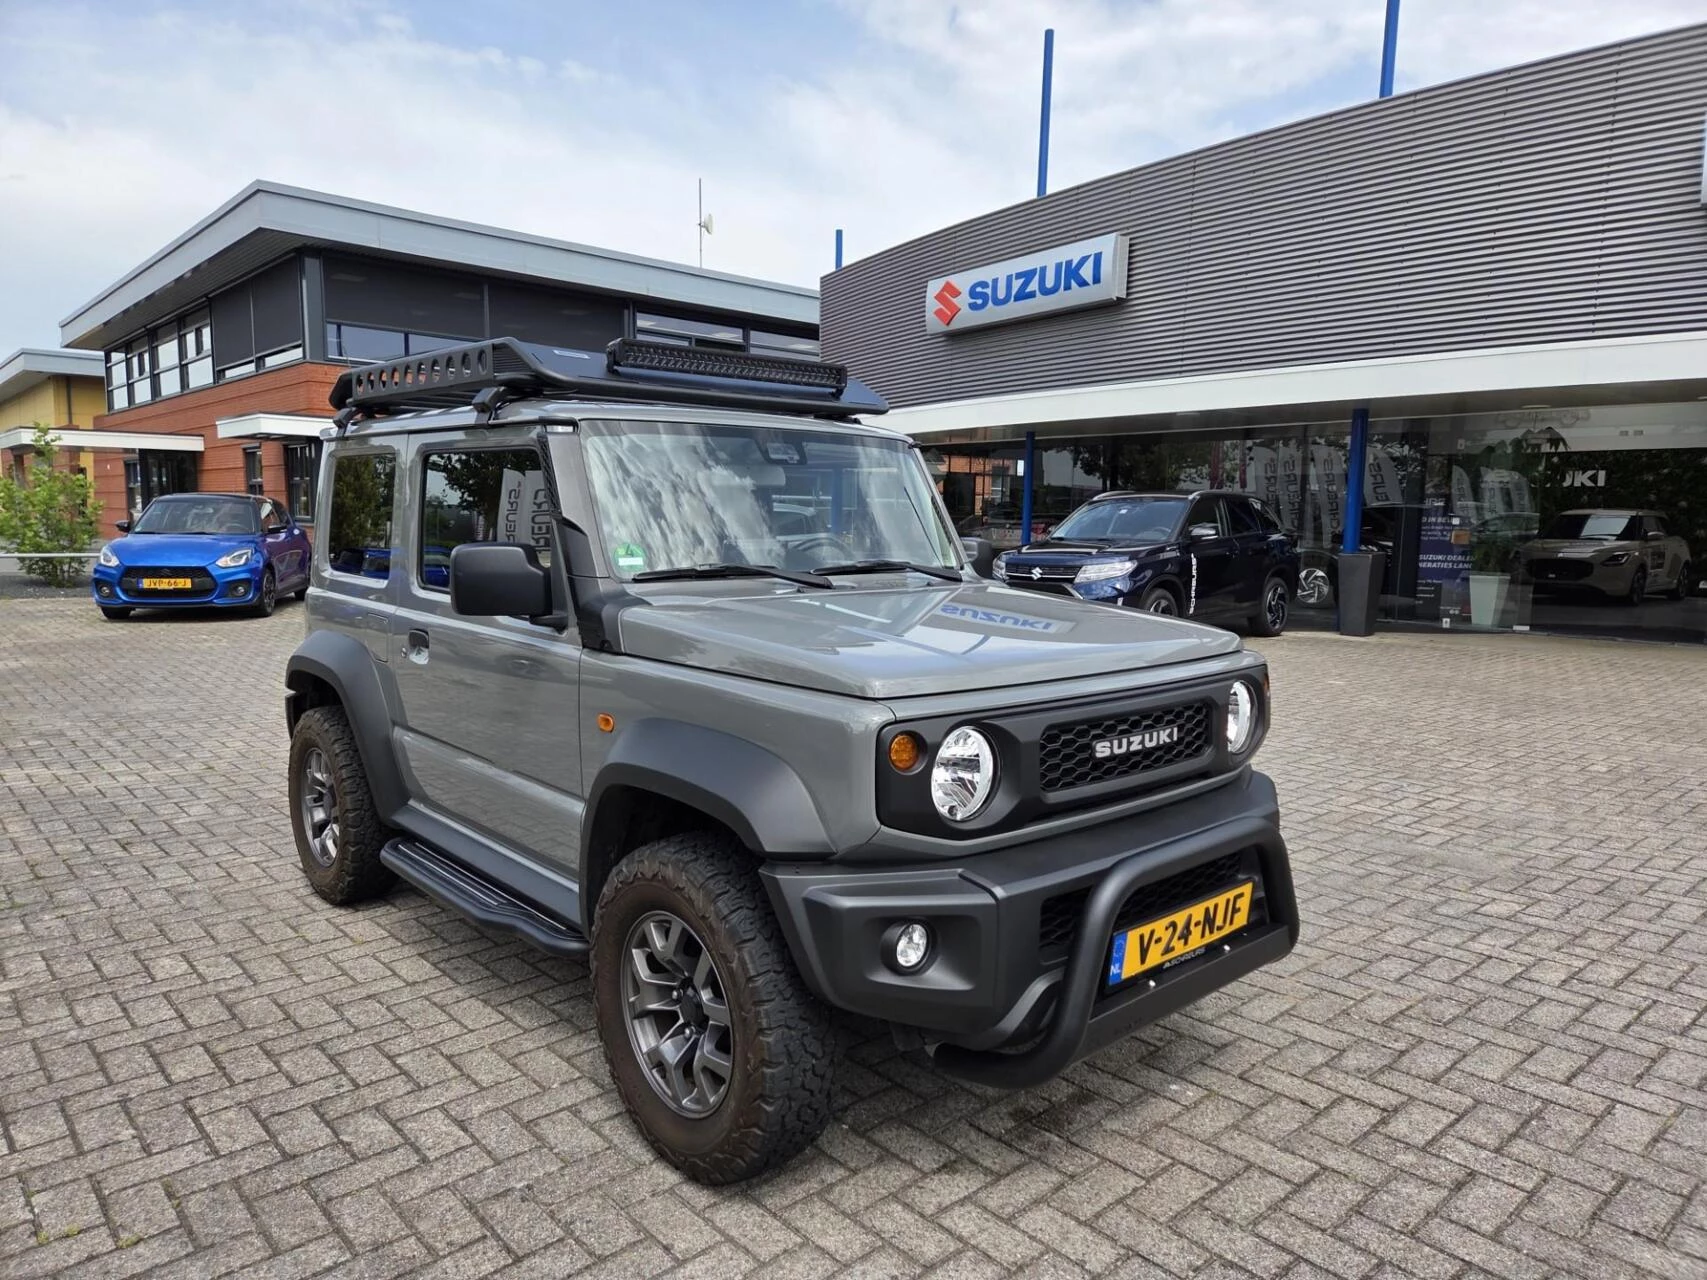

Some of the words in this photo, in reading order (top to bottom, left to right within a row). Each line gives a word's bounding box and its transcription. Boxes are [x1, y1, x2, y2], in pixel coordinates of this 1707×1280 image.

[968, 252, 1103, 312] SUZUKI
[1095, 727, 1178, 758] SUZUKI
[1138, 892, 1245, 965] V-24-NJF
[1110, 964, 1121, 976] NL
